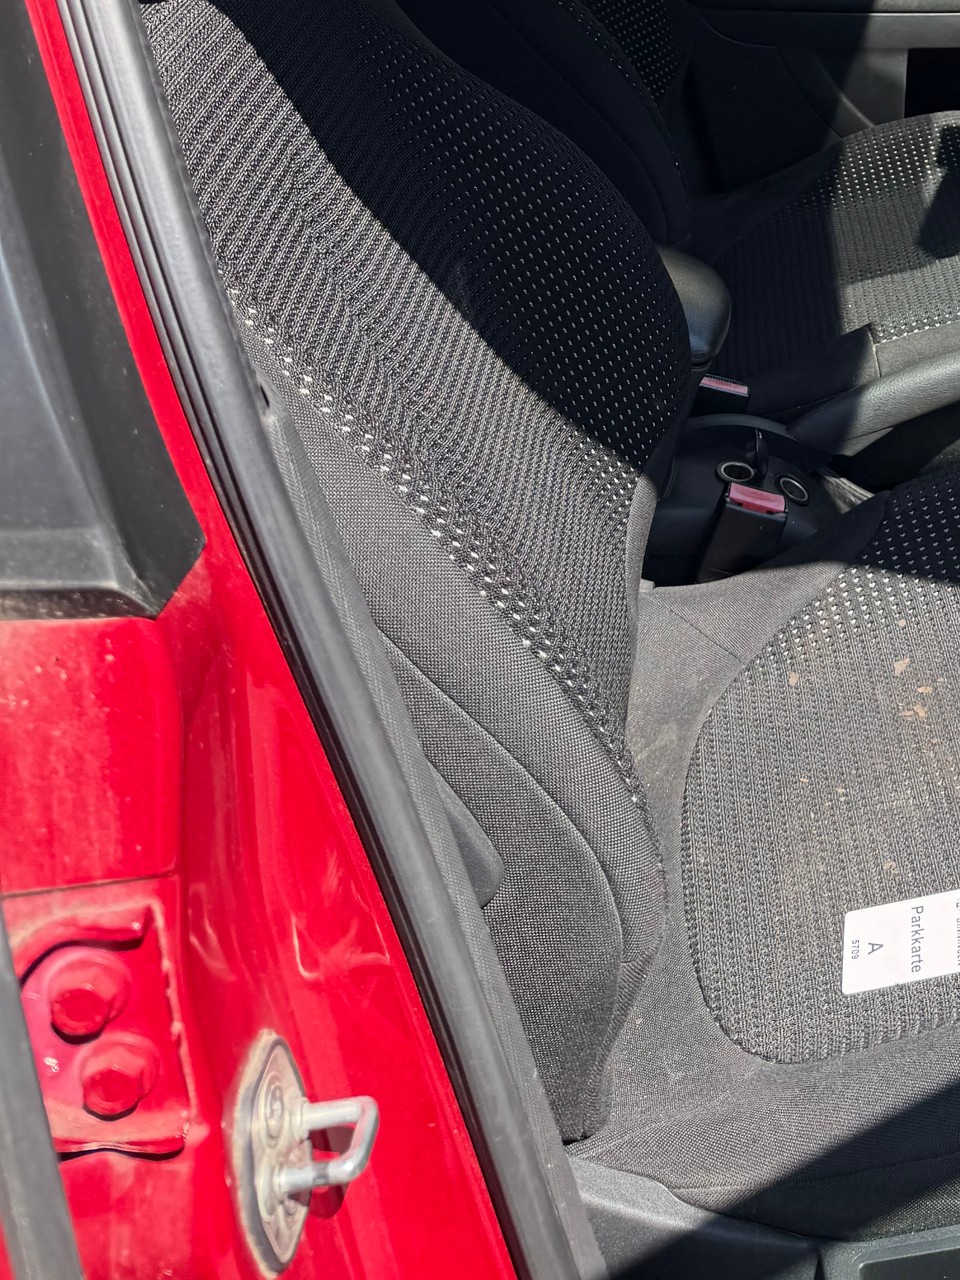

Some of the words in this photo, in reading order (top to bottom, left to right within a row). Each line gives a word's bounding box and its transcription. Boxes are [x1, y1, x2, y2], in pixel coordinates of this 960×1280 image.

[851, 939, 860, 960] 5709
[868, 942, 884, 955] A
[911, 905, 924, 973] Parkkarte
